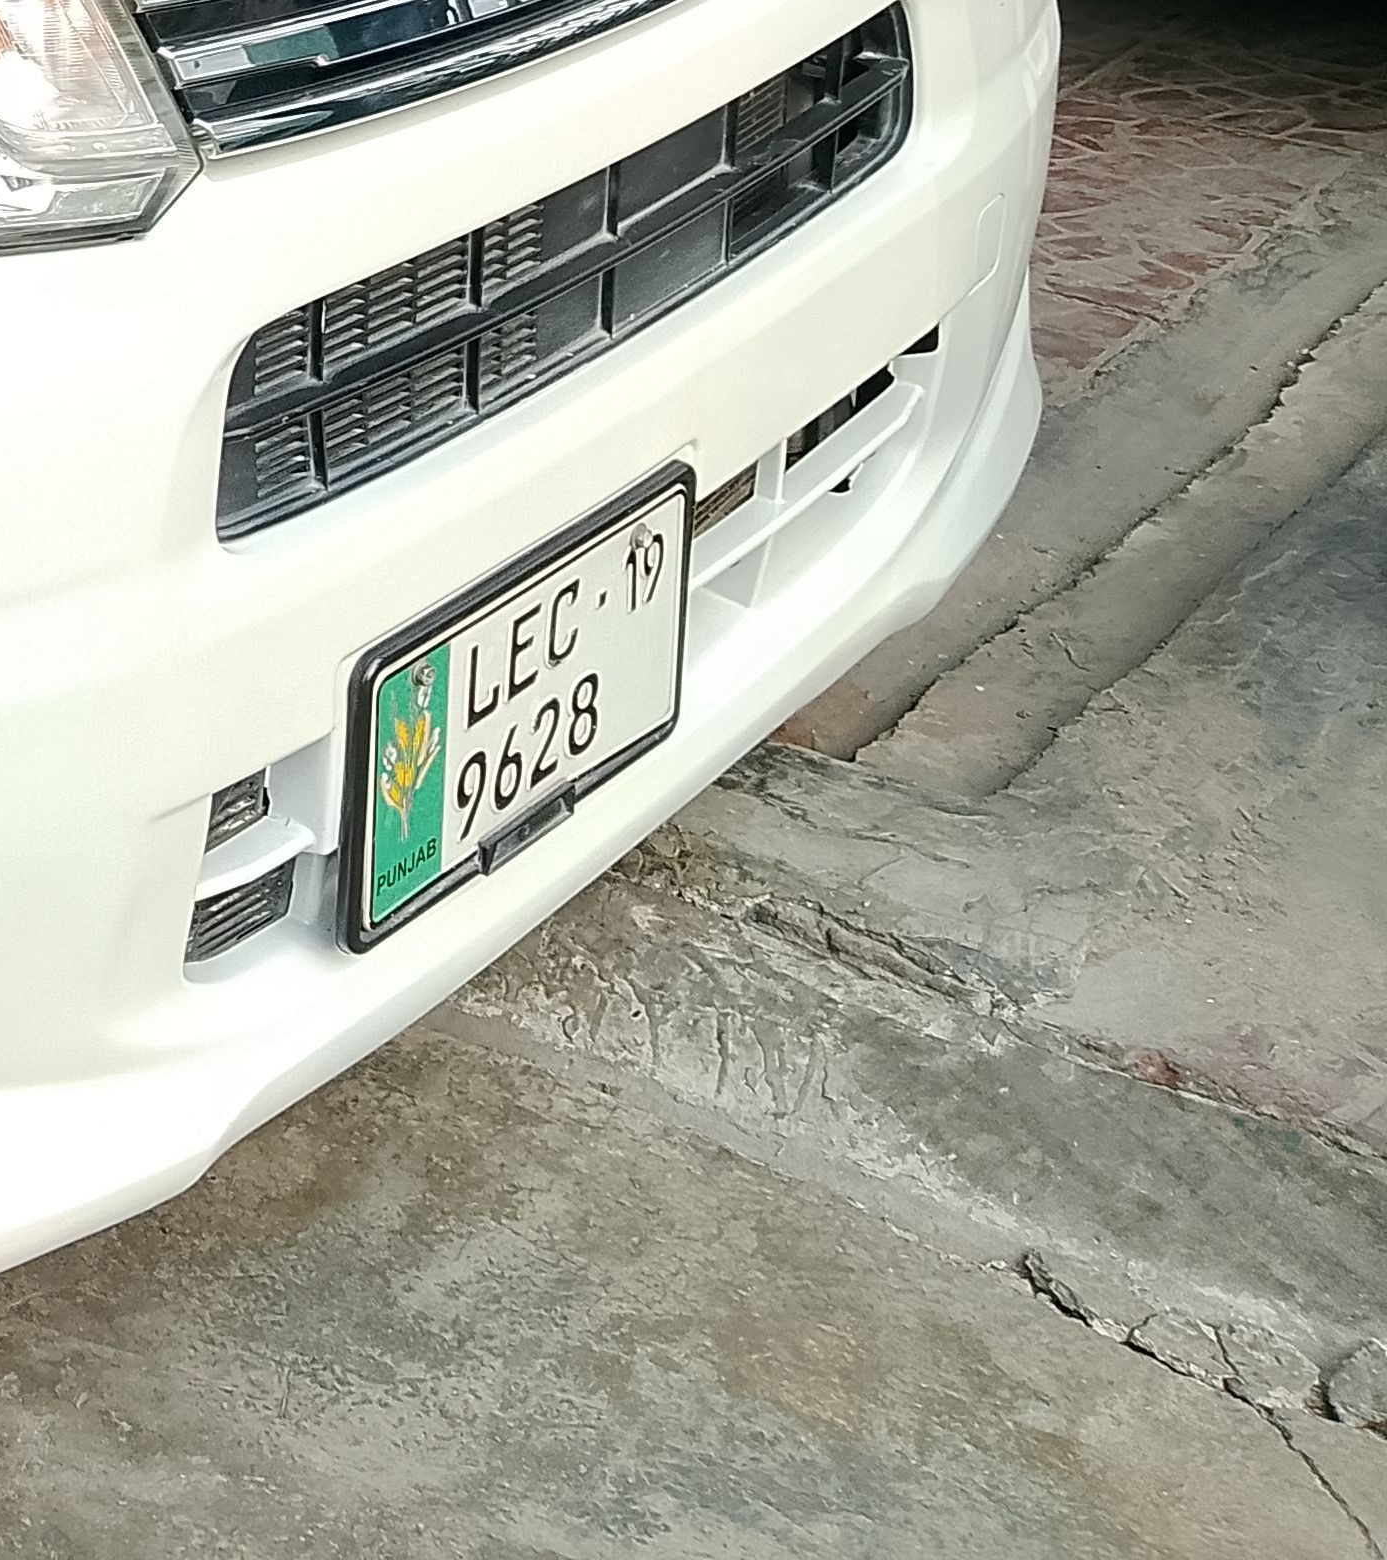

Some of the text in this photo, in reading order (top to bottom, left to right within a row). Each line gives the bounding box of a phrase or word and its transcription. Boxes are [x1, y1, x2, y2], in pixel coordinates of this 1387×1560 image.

[464, 577, 581, 730] LEC
[455, 671, 601, 843] 9628
[375, 836, 438, 897] PUNJAB
